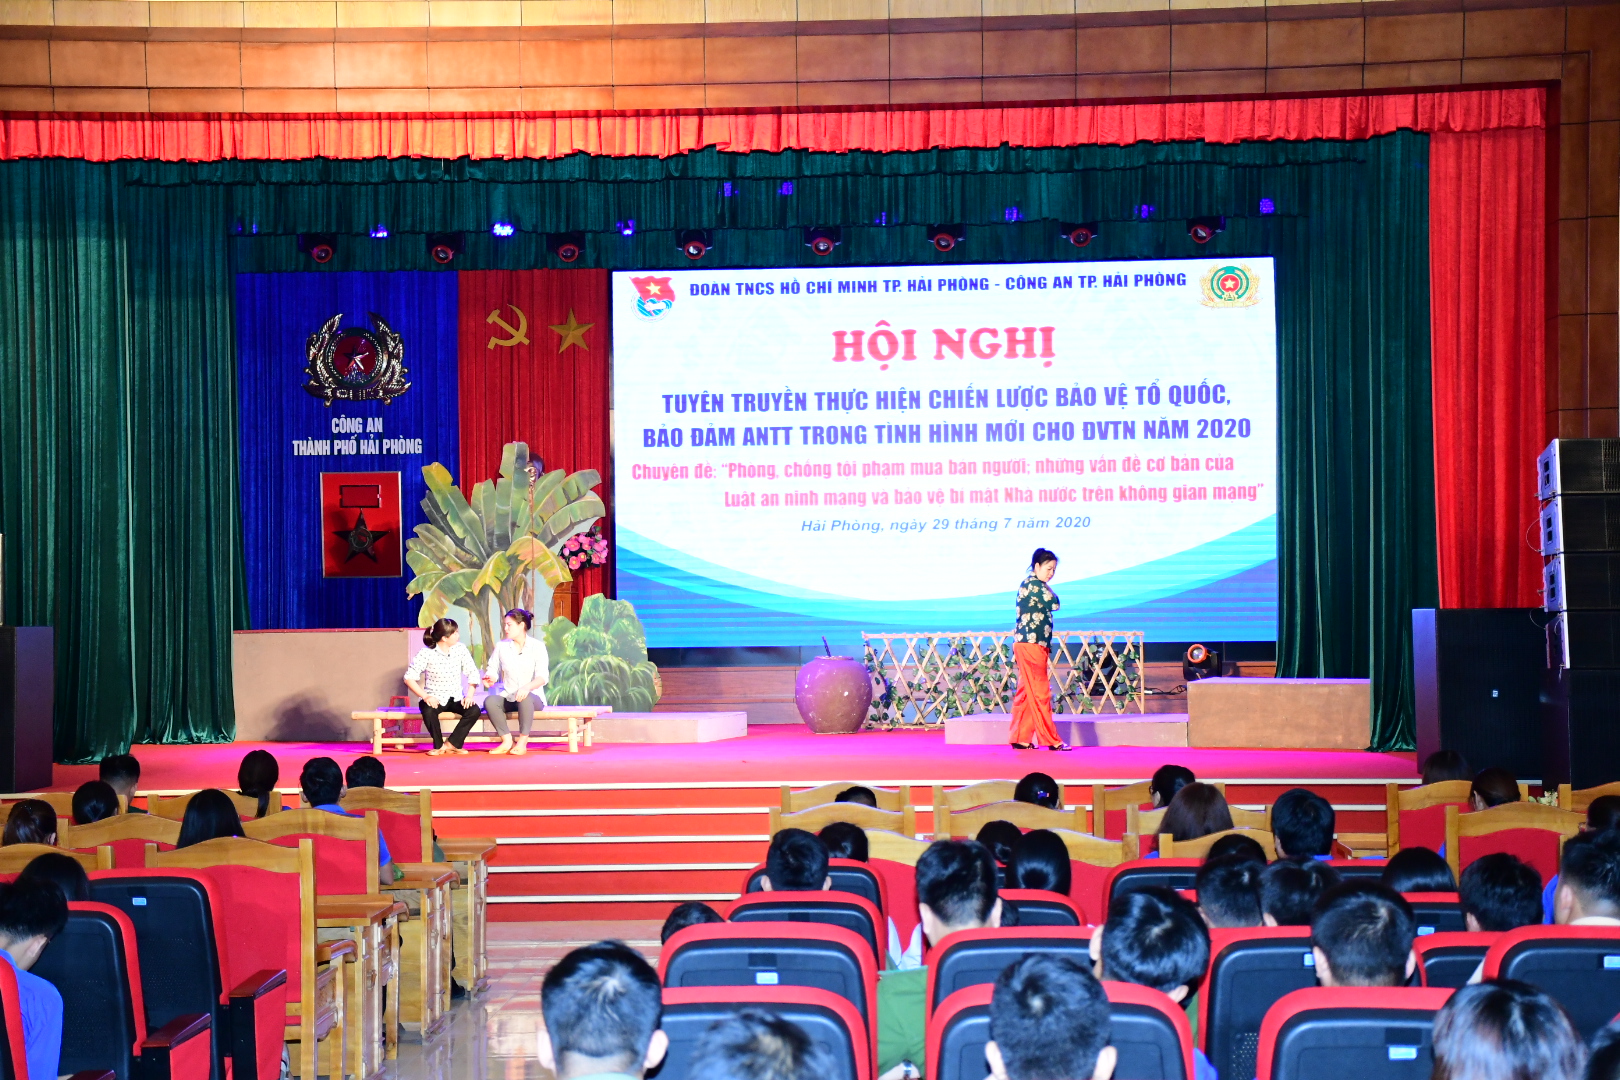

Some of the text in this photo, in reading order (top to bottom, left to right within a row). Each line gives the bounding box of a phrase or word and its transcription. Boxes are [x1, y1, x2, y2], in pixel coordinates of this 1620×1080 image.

[690, 281, 730, 296] ĐOÀN
[736, 282, 774, 296] TNCS
[780, 277, 801, 295] HỒ
[806, 278, 832, 294] CHÍ
[838, 280, 877, 294] MINH
[883, 279, 902, 293] TP.
[908, 276, 932, 292] HẢI
[938, 275, 990, 291] PHÒNG
[1005, 274, 1047, 290] CÔNG
[1053, 276, 1073, 289] AN
[1078, 275, 1097, 288] TP.
[1103, 272, 1128, 288] HẢI
[1134, 271, 1187, 287] PHÒNG
[832, 319, 1056, 371] HỘI NGHỊ
[662, 378, 1230, 414] TUYÊN TRUYỀN THỰC HIỆN CHIẾN LƯỢC BẢO VỆ TỔ QUỐC,
[331, 414, 383, 434] CÔNG AN
[643, 416, 1251, 447] BẢO ĐẢM ANTT TRONG TÌNH HÌNH MỚI CHO ĐVTN NĂM 2020
[292, 434, 422, 455] THÀNH PHỐ HẢI PHÒNG
[632, 463, 689, 481] Chuyên
[694, 461, 717, 479] đề:
[784, 459, 832, 479] chống
[862, 461, 905, 479] phạm
[911, 461, 943, 476] mua
[1089, 454, 1116, 473] vấn
[1122, 453, 1141, 472] đề
[1147, 456, 1166, 472] cơ
[725, 491, 756, 510] Luật
[761, 493, 779, 506] an
[785, 490, 818, 506] ninh
[824, 492, 866, 509] mạng
[872, 489, 889, 505] và
[927, 488, 945, 507] vệ
[1004, 487, 1033, 503] Nhà
[1039, 486, 1077, 502] nước
[1082, 486, 1114, 502] trên
[1119, 485, 1167, 503] không
[1173, 485, 1207, 503] gian
[801, 516, 1091, 533] Hải Phòng, ngày 29 tháng 7 năm 2020
